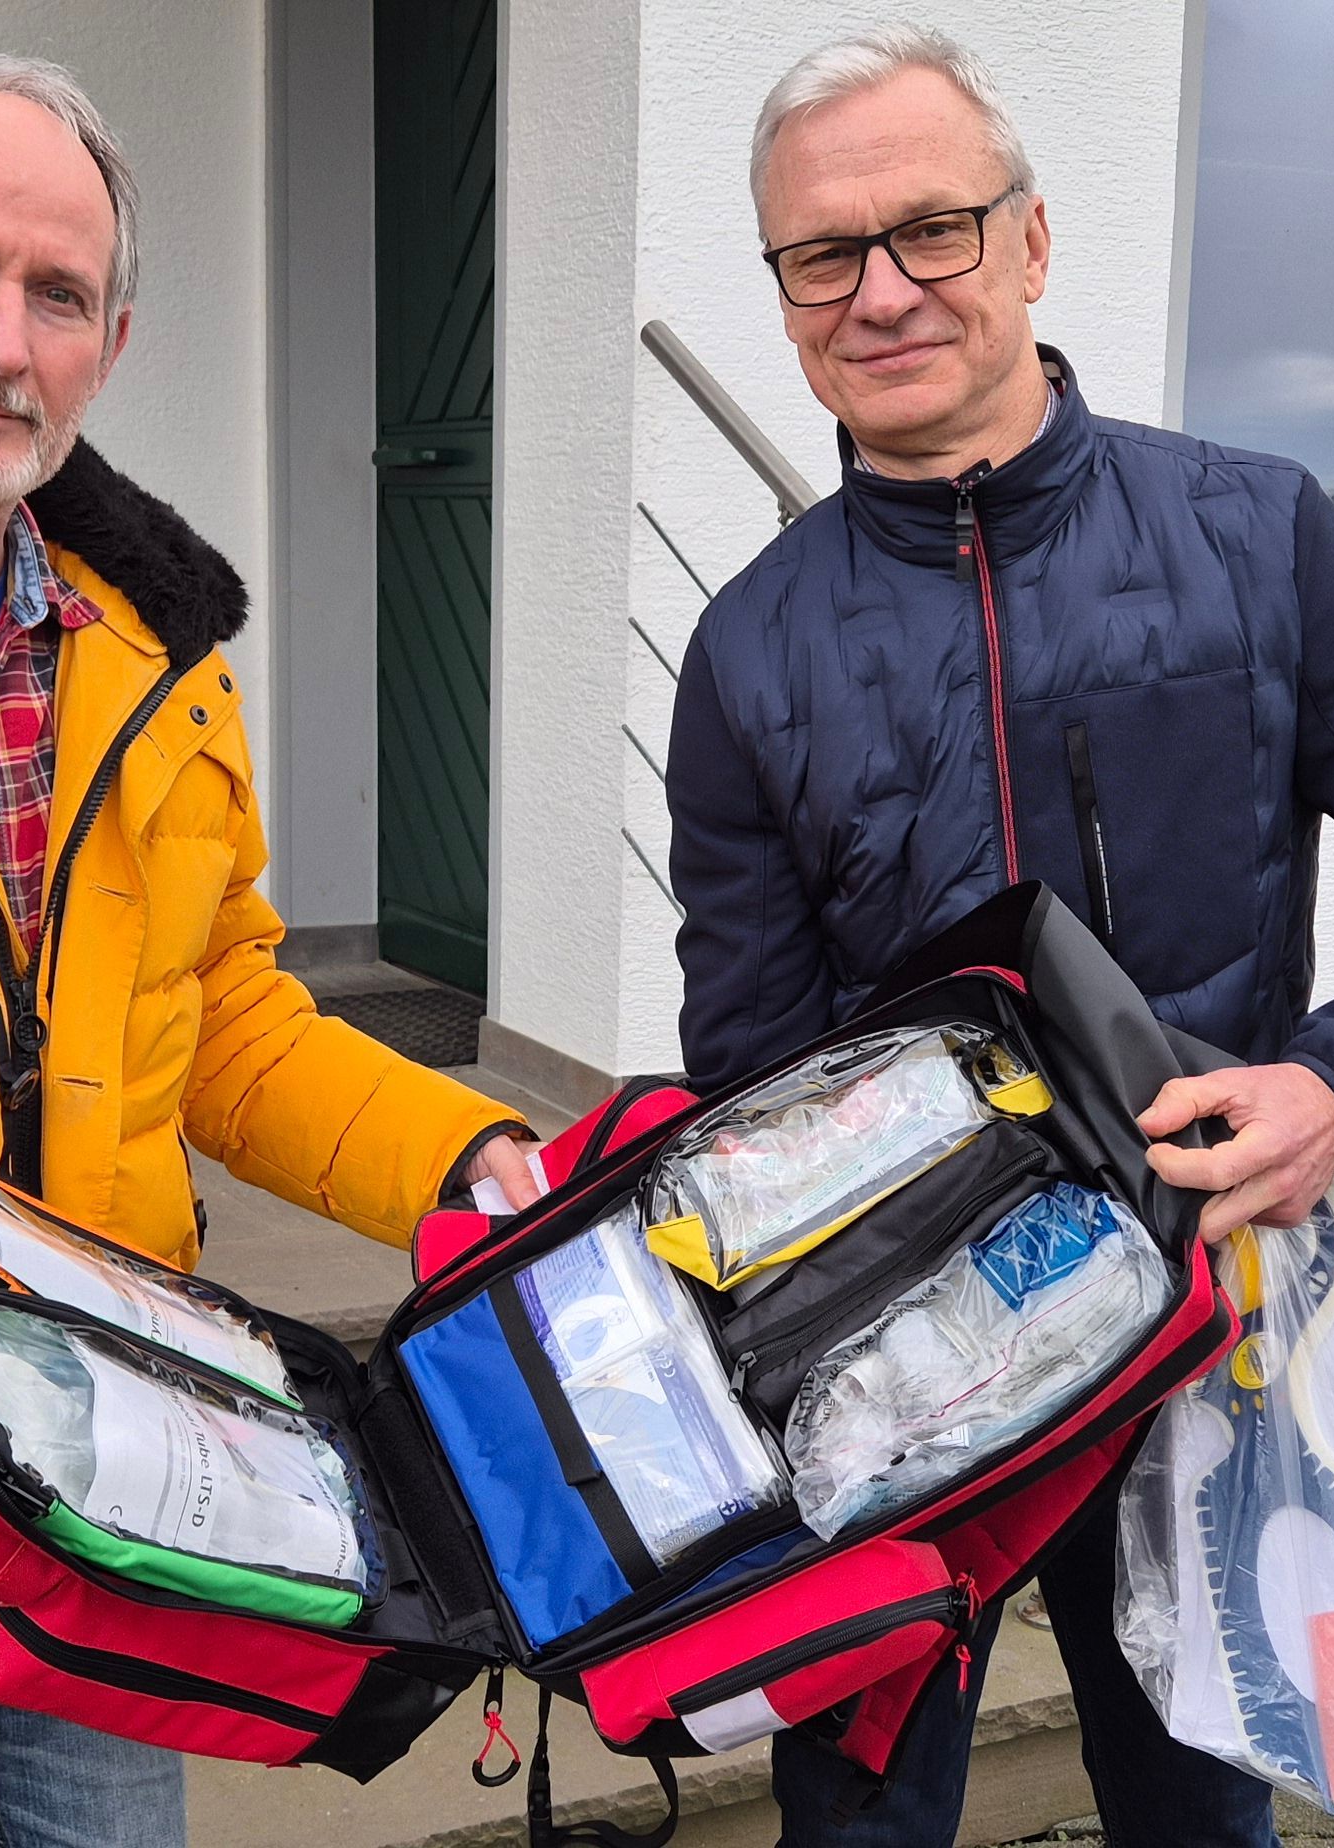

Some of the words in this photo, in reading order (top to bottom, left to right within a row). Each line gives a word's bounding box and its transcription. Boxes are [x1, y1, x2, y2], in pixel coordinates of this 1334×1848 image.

[851, 1333, 875, 1356] Use
[195, 1431, 211, 1469] Tube
[191, 1474, 214, 1528] LTS-D
